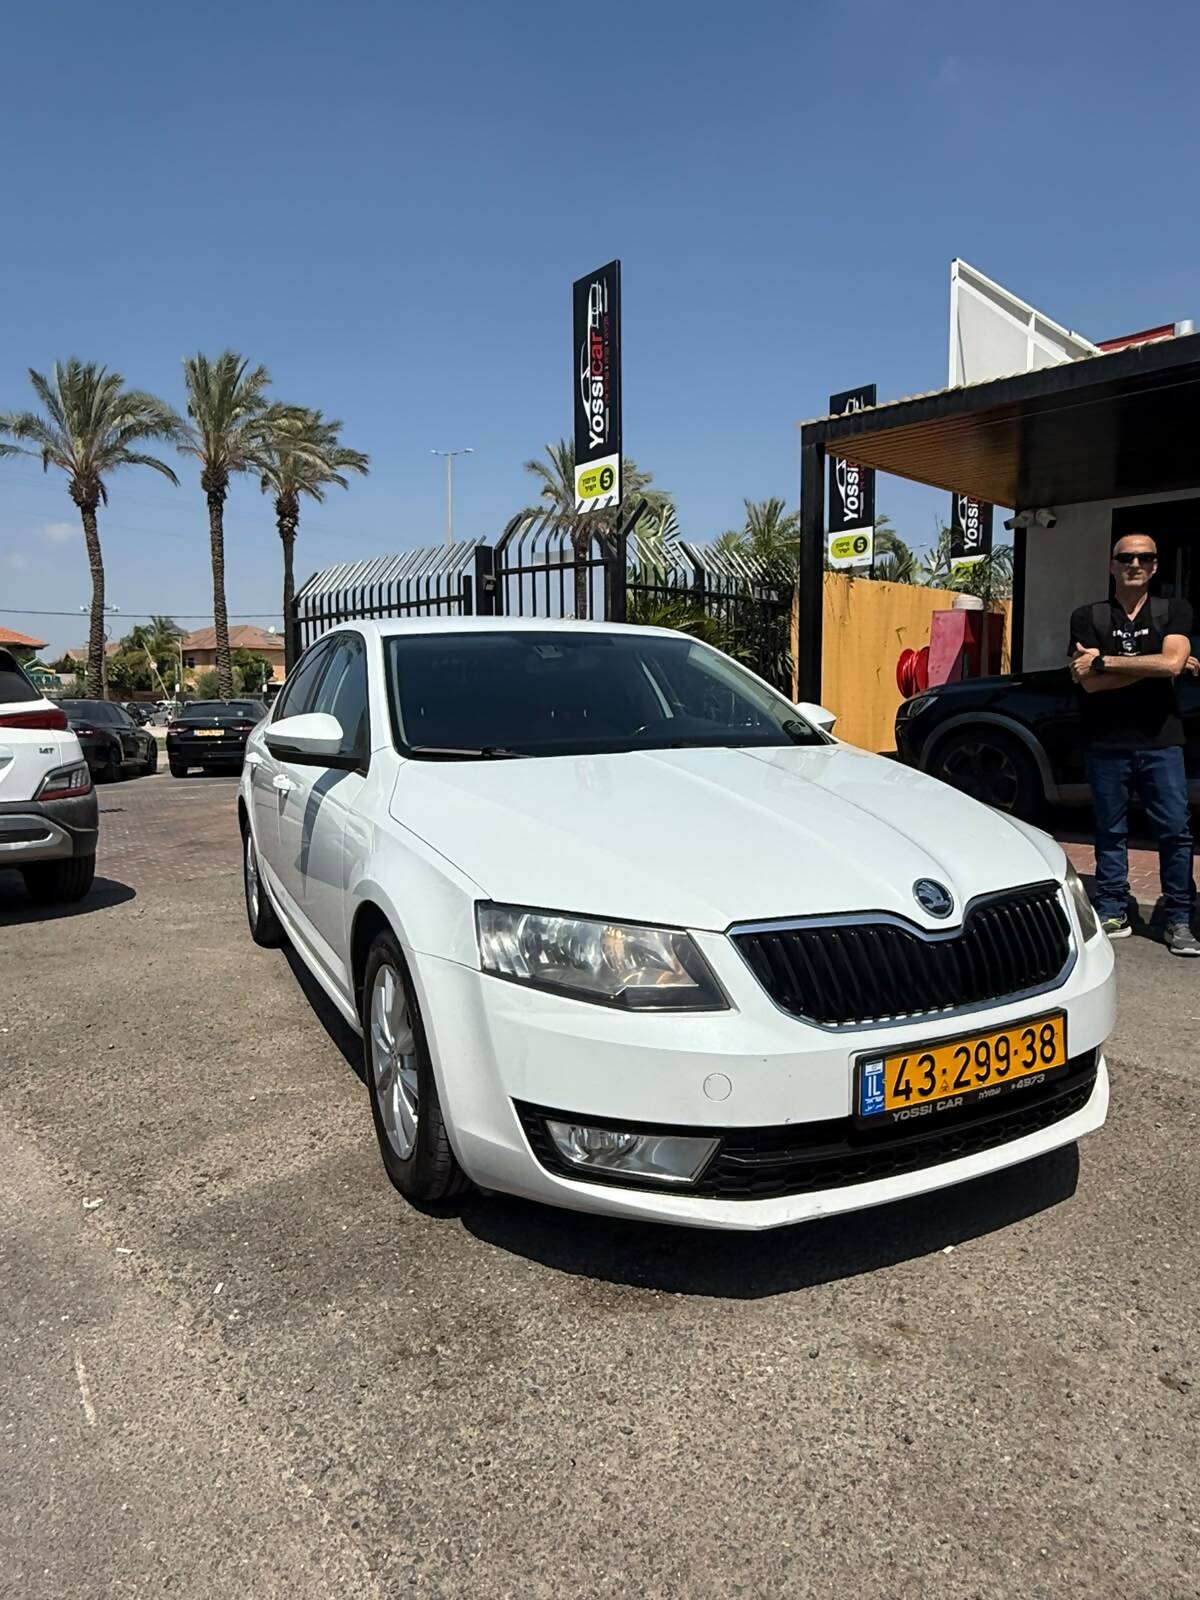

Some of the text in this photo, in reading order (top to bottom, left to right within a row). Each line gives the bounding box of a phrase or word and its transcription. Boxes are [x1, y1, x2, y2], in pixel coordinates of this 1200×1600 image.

[589, 331, 604, 450] Yossicar
[867, 1074, 881, 1097] IL
[892, 1097, 964, 1122] YOSSI CAR
